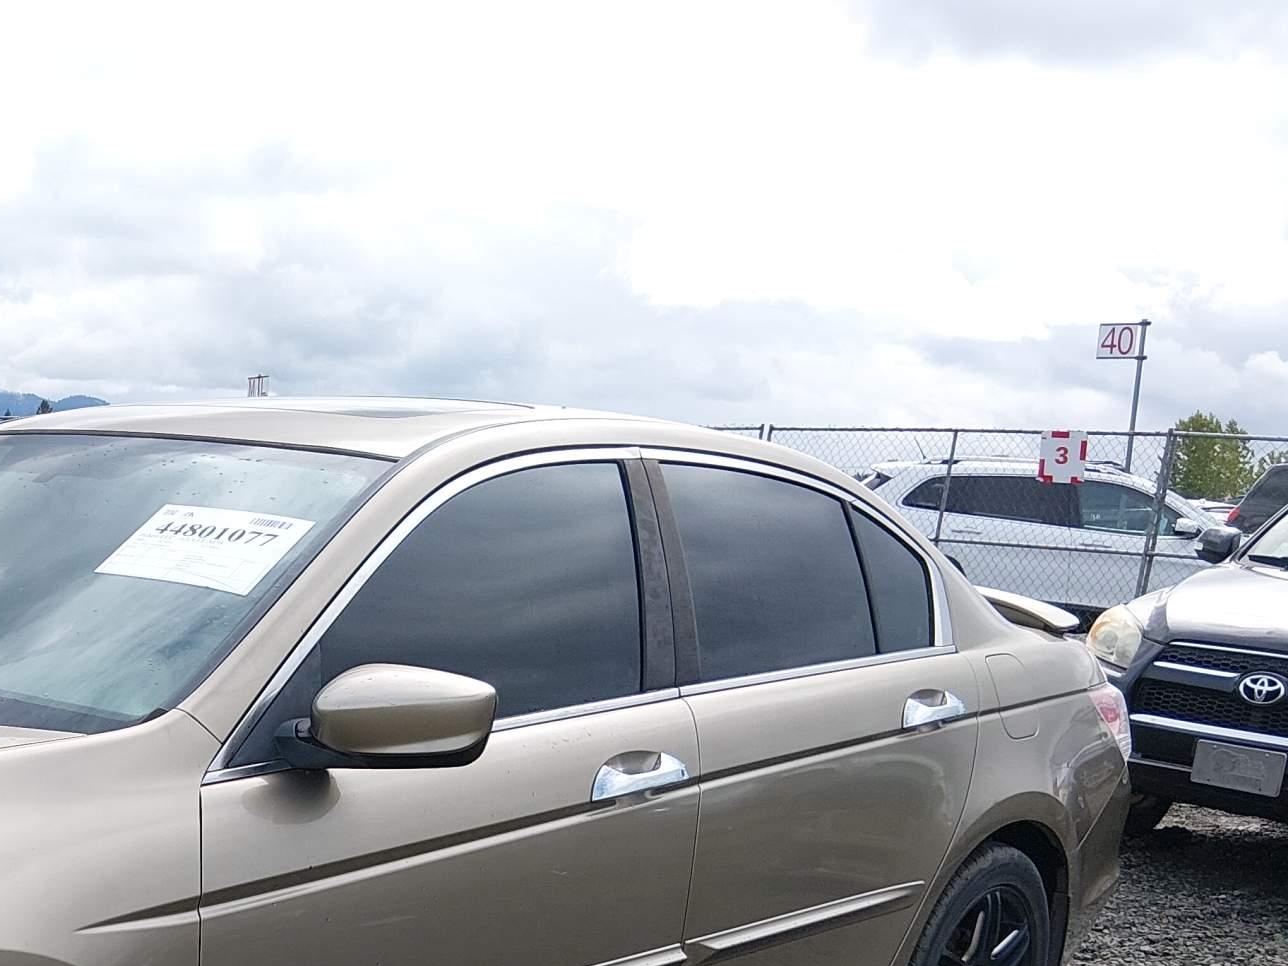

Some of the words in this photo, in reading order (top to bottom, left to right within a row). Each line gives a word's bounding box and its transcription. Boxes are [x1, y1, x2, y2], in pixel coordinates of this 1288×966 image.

[1101, 327, 1134, 355] 40
[1055, 446, 1069, 465] 3
[156, 521, 280, 547] 44801077
